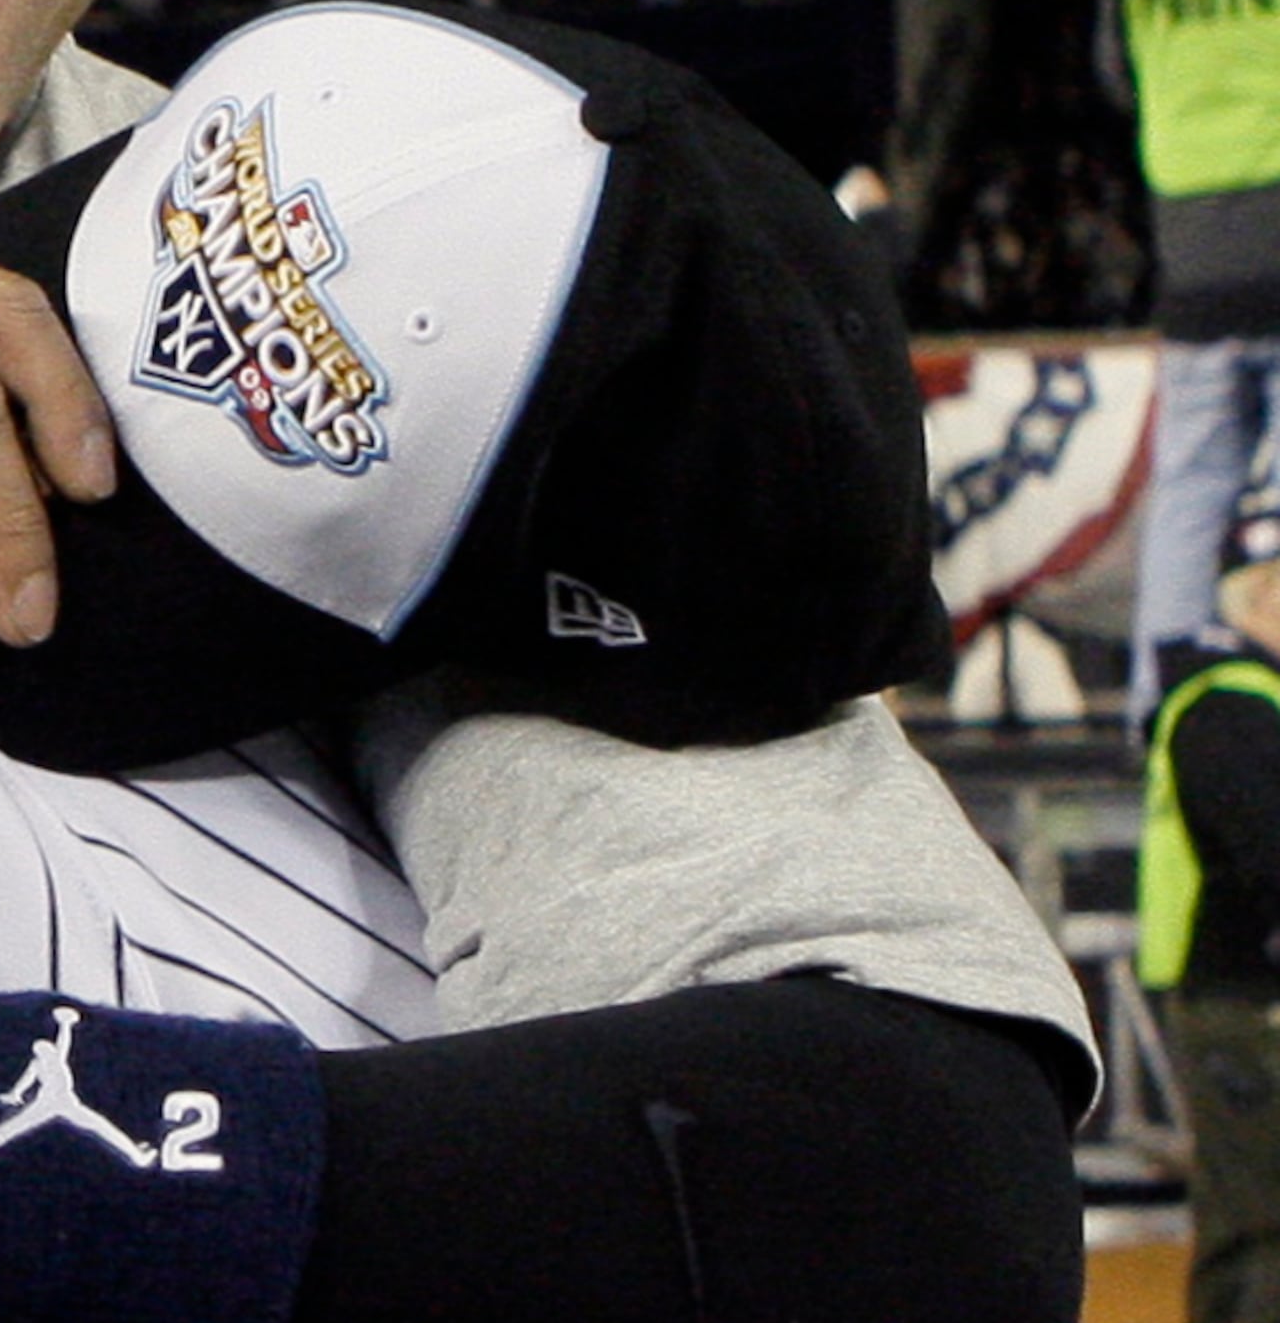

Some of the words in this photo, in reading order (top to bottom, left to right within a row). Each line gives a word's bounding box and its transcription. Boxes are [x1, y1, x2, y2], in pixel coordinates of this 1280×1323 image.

[193, 106, 374, 462] CHAMPIONS
[236, 119, 285, 264] WORLD
[267, 266, 373, 401] SERIES
[160, 1090, 225, 1172] 2
